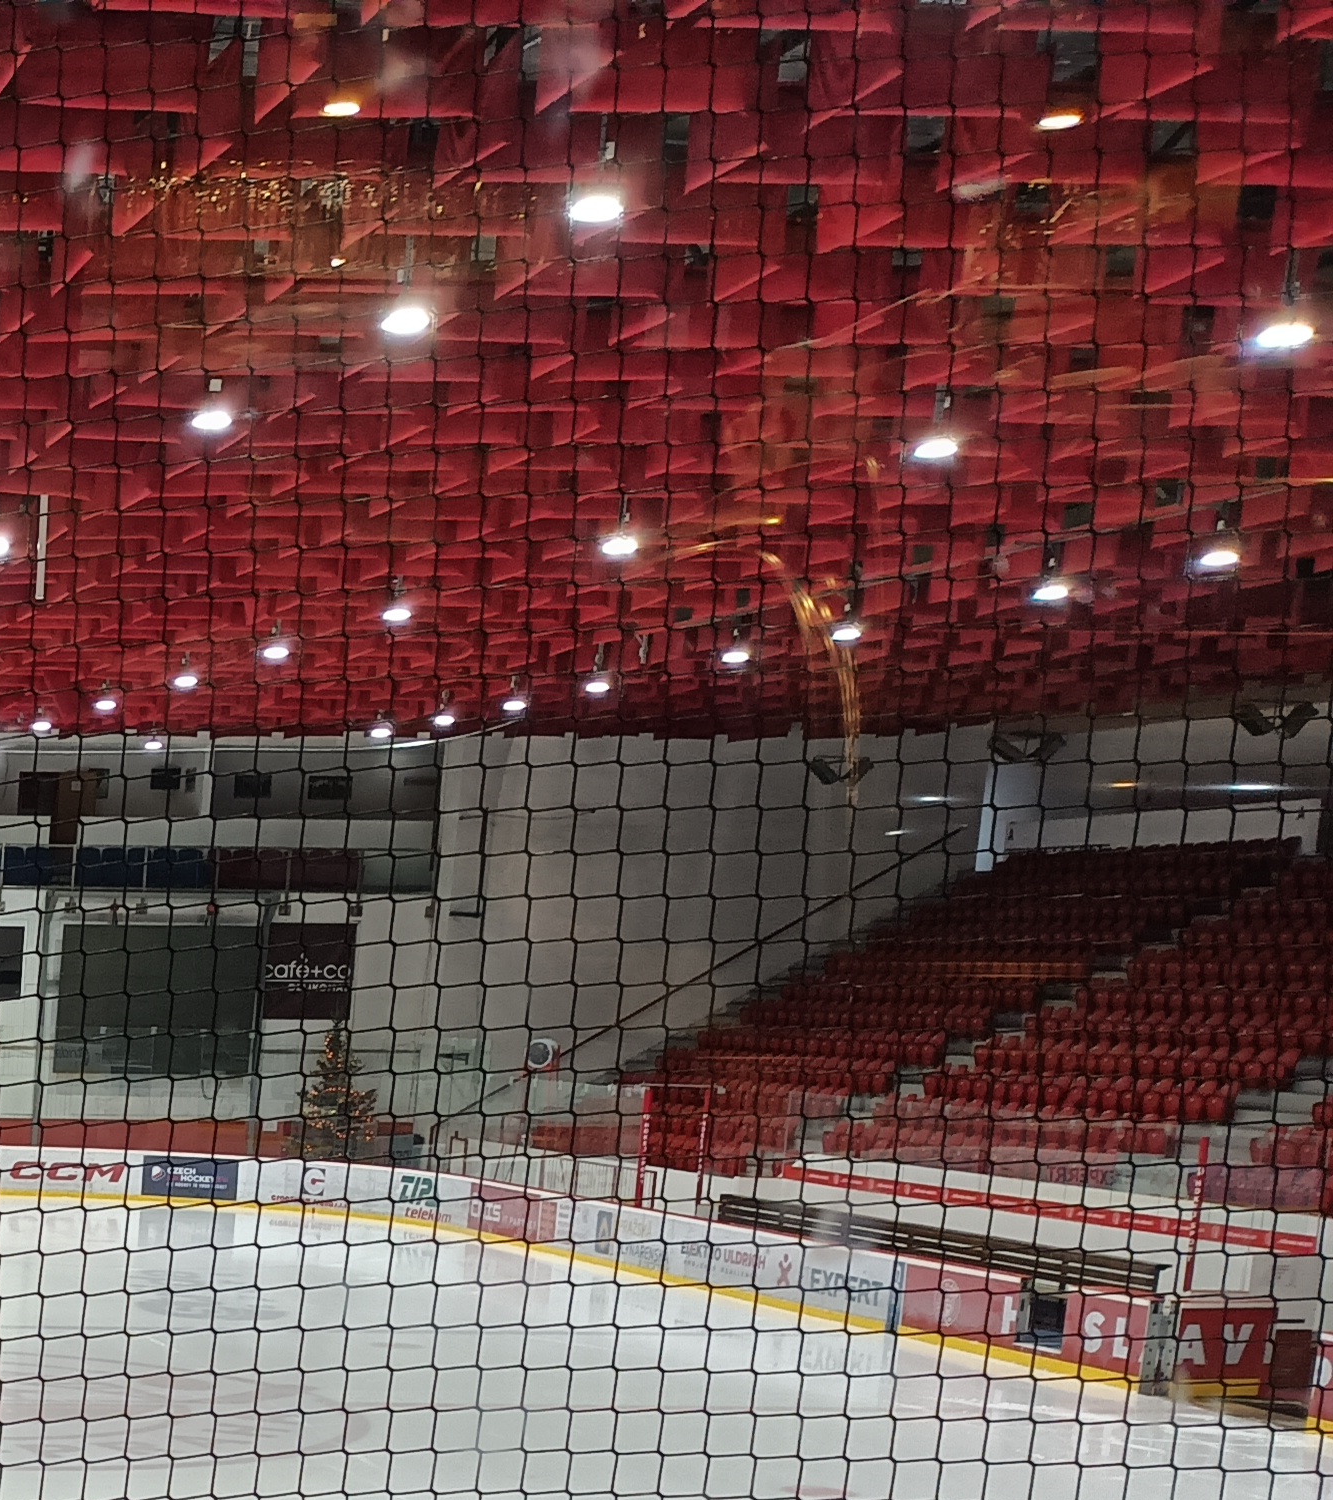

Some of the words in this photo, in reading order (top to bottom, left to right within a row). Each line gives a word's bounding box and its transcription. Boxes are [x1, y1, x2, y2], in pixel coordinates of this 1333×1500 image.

[10, 1160, 125, 1183] CCM
[180, 1174, 215, 1184] HOCKEY
[810, 1267, 884, 1309] EXPERT
